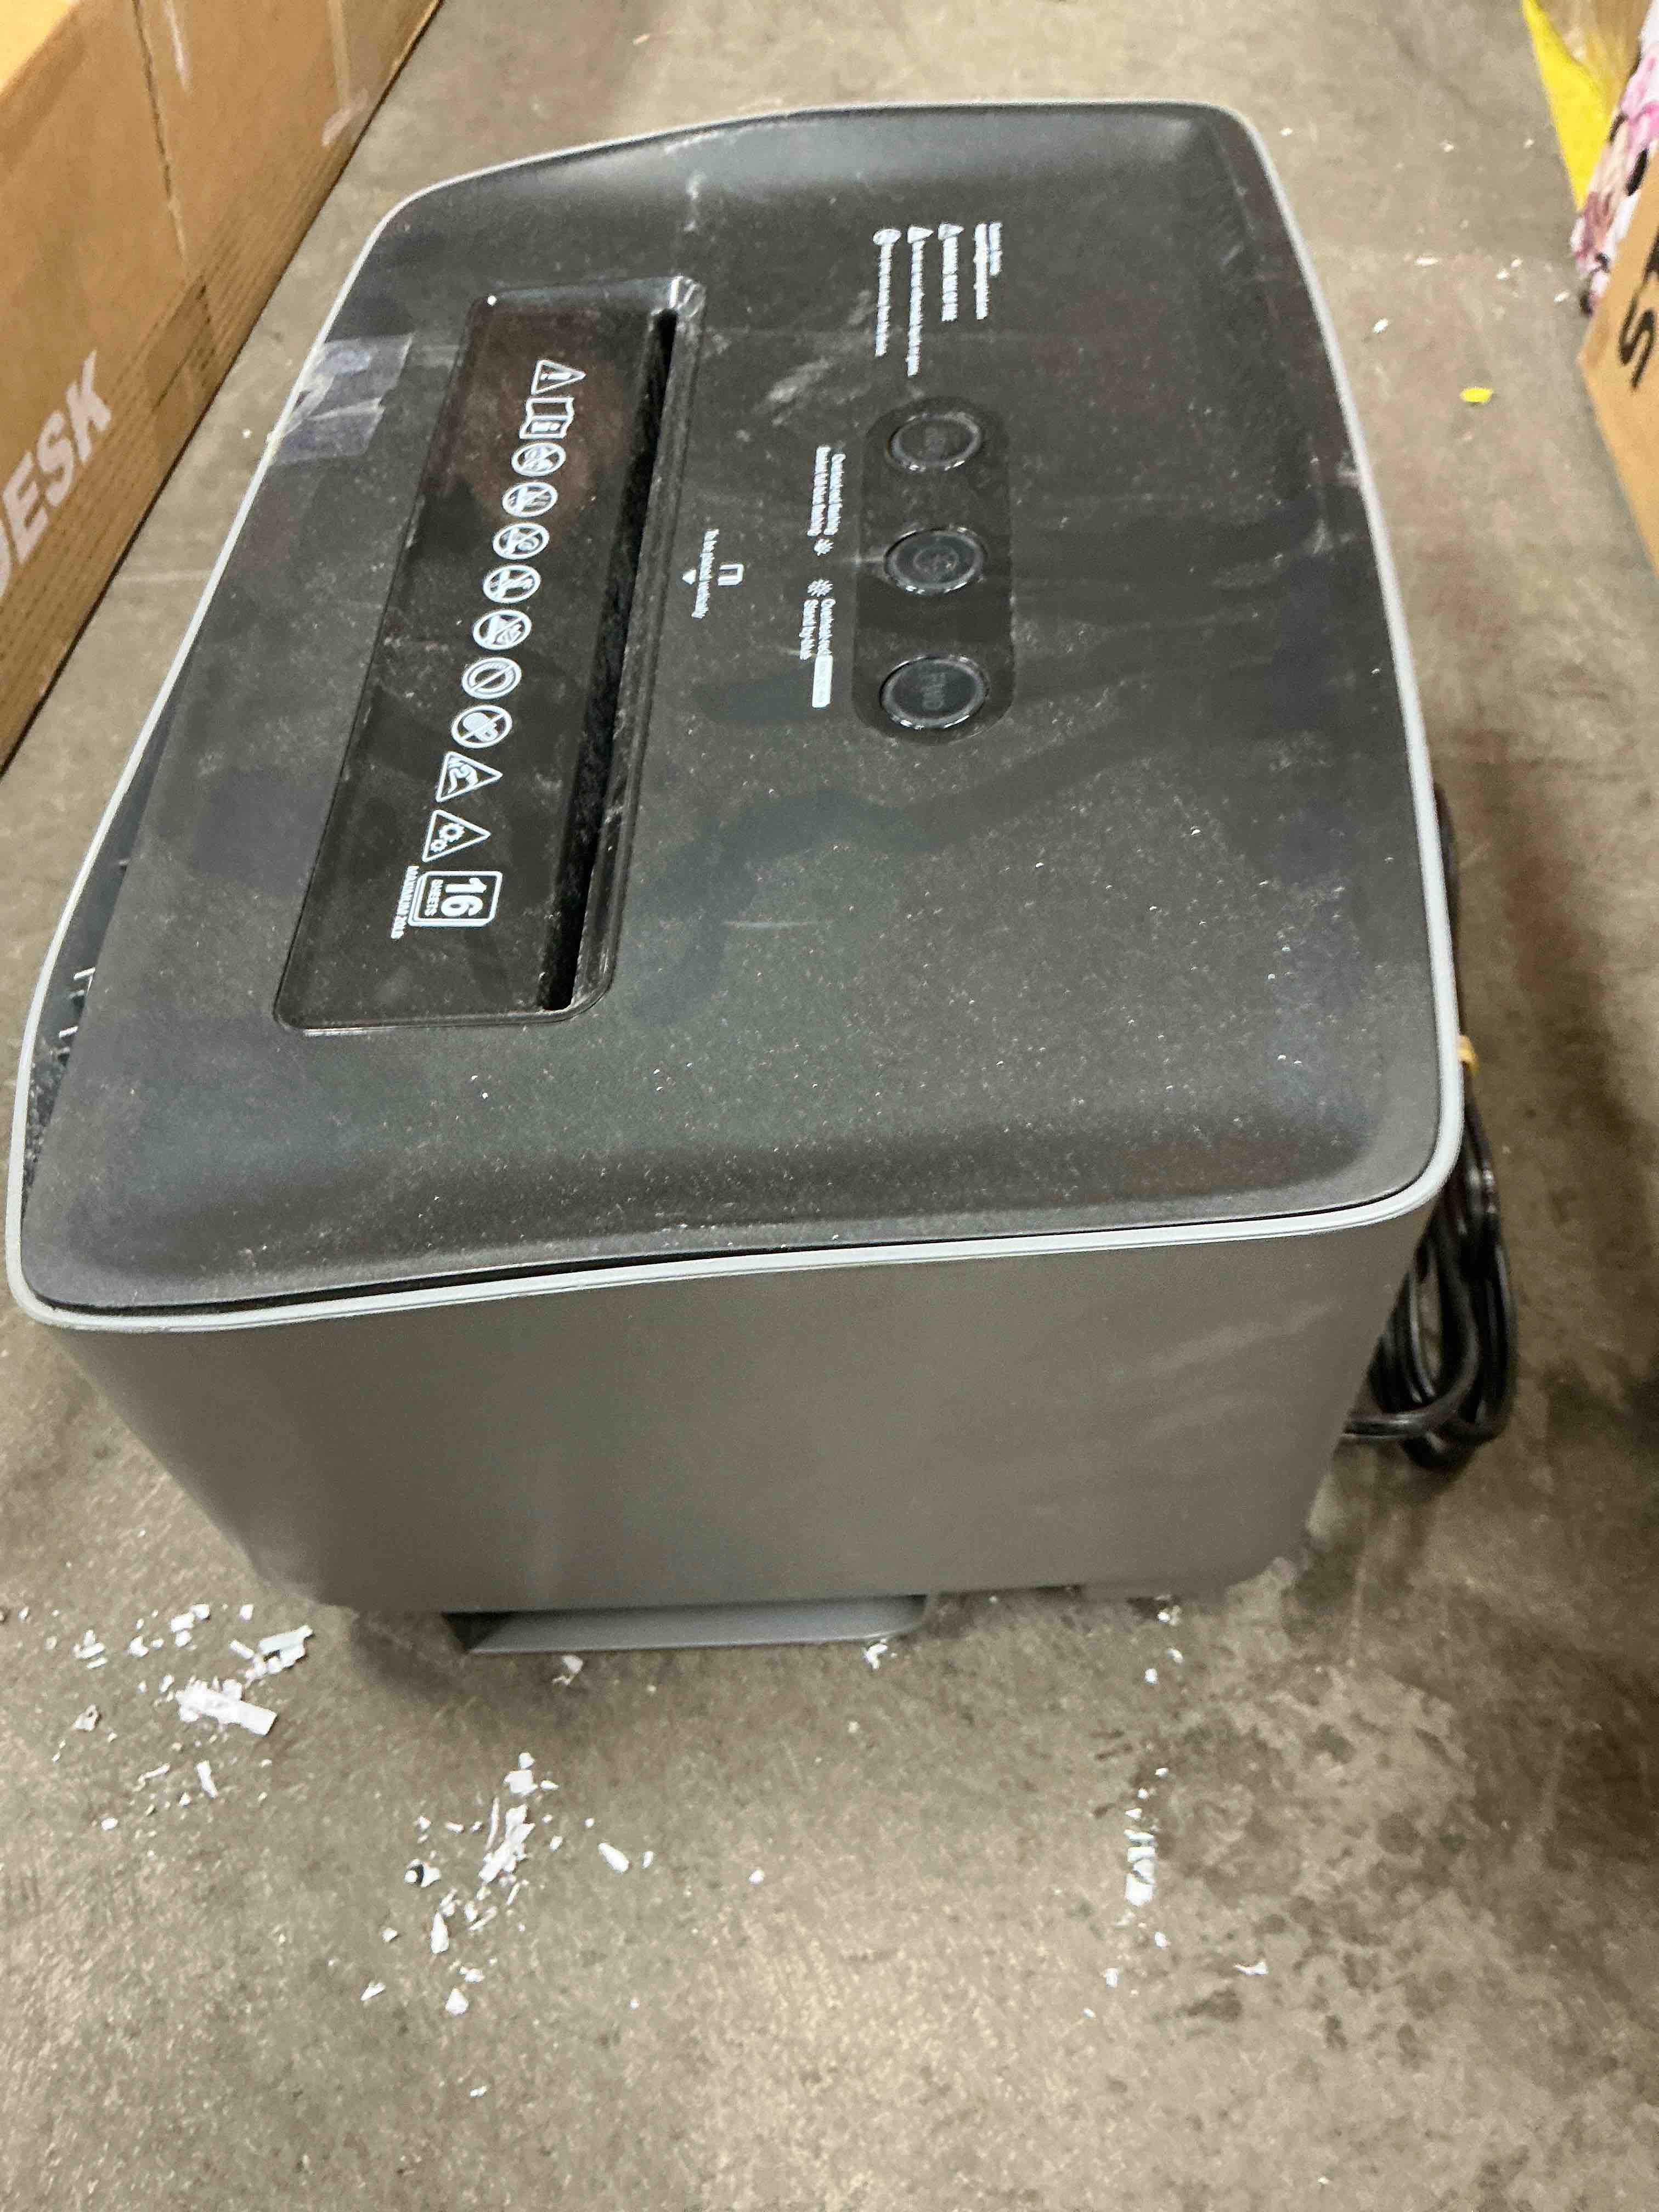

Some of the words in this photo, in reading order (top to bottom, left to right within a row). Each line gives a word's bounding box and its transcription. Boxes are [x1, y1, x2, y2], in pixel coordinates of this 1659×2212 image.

[0, 349, 111, 598] ESK
[425, 879, 444, 916] SHEETS
[441, 877, 488, 916] 16
